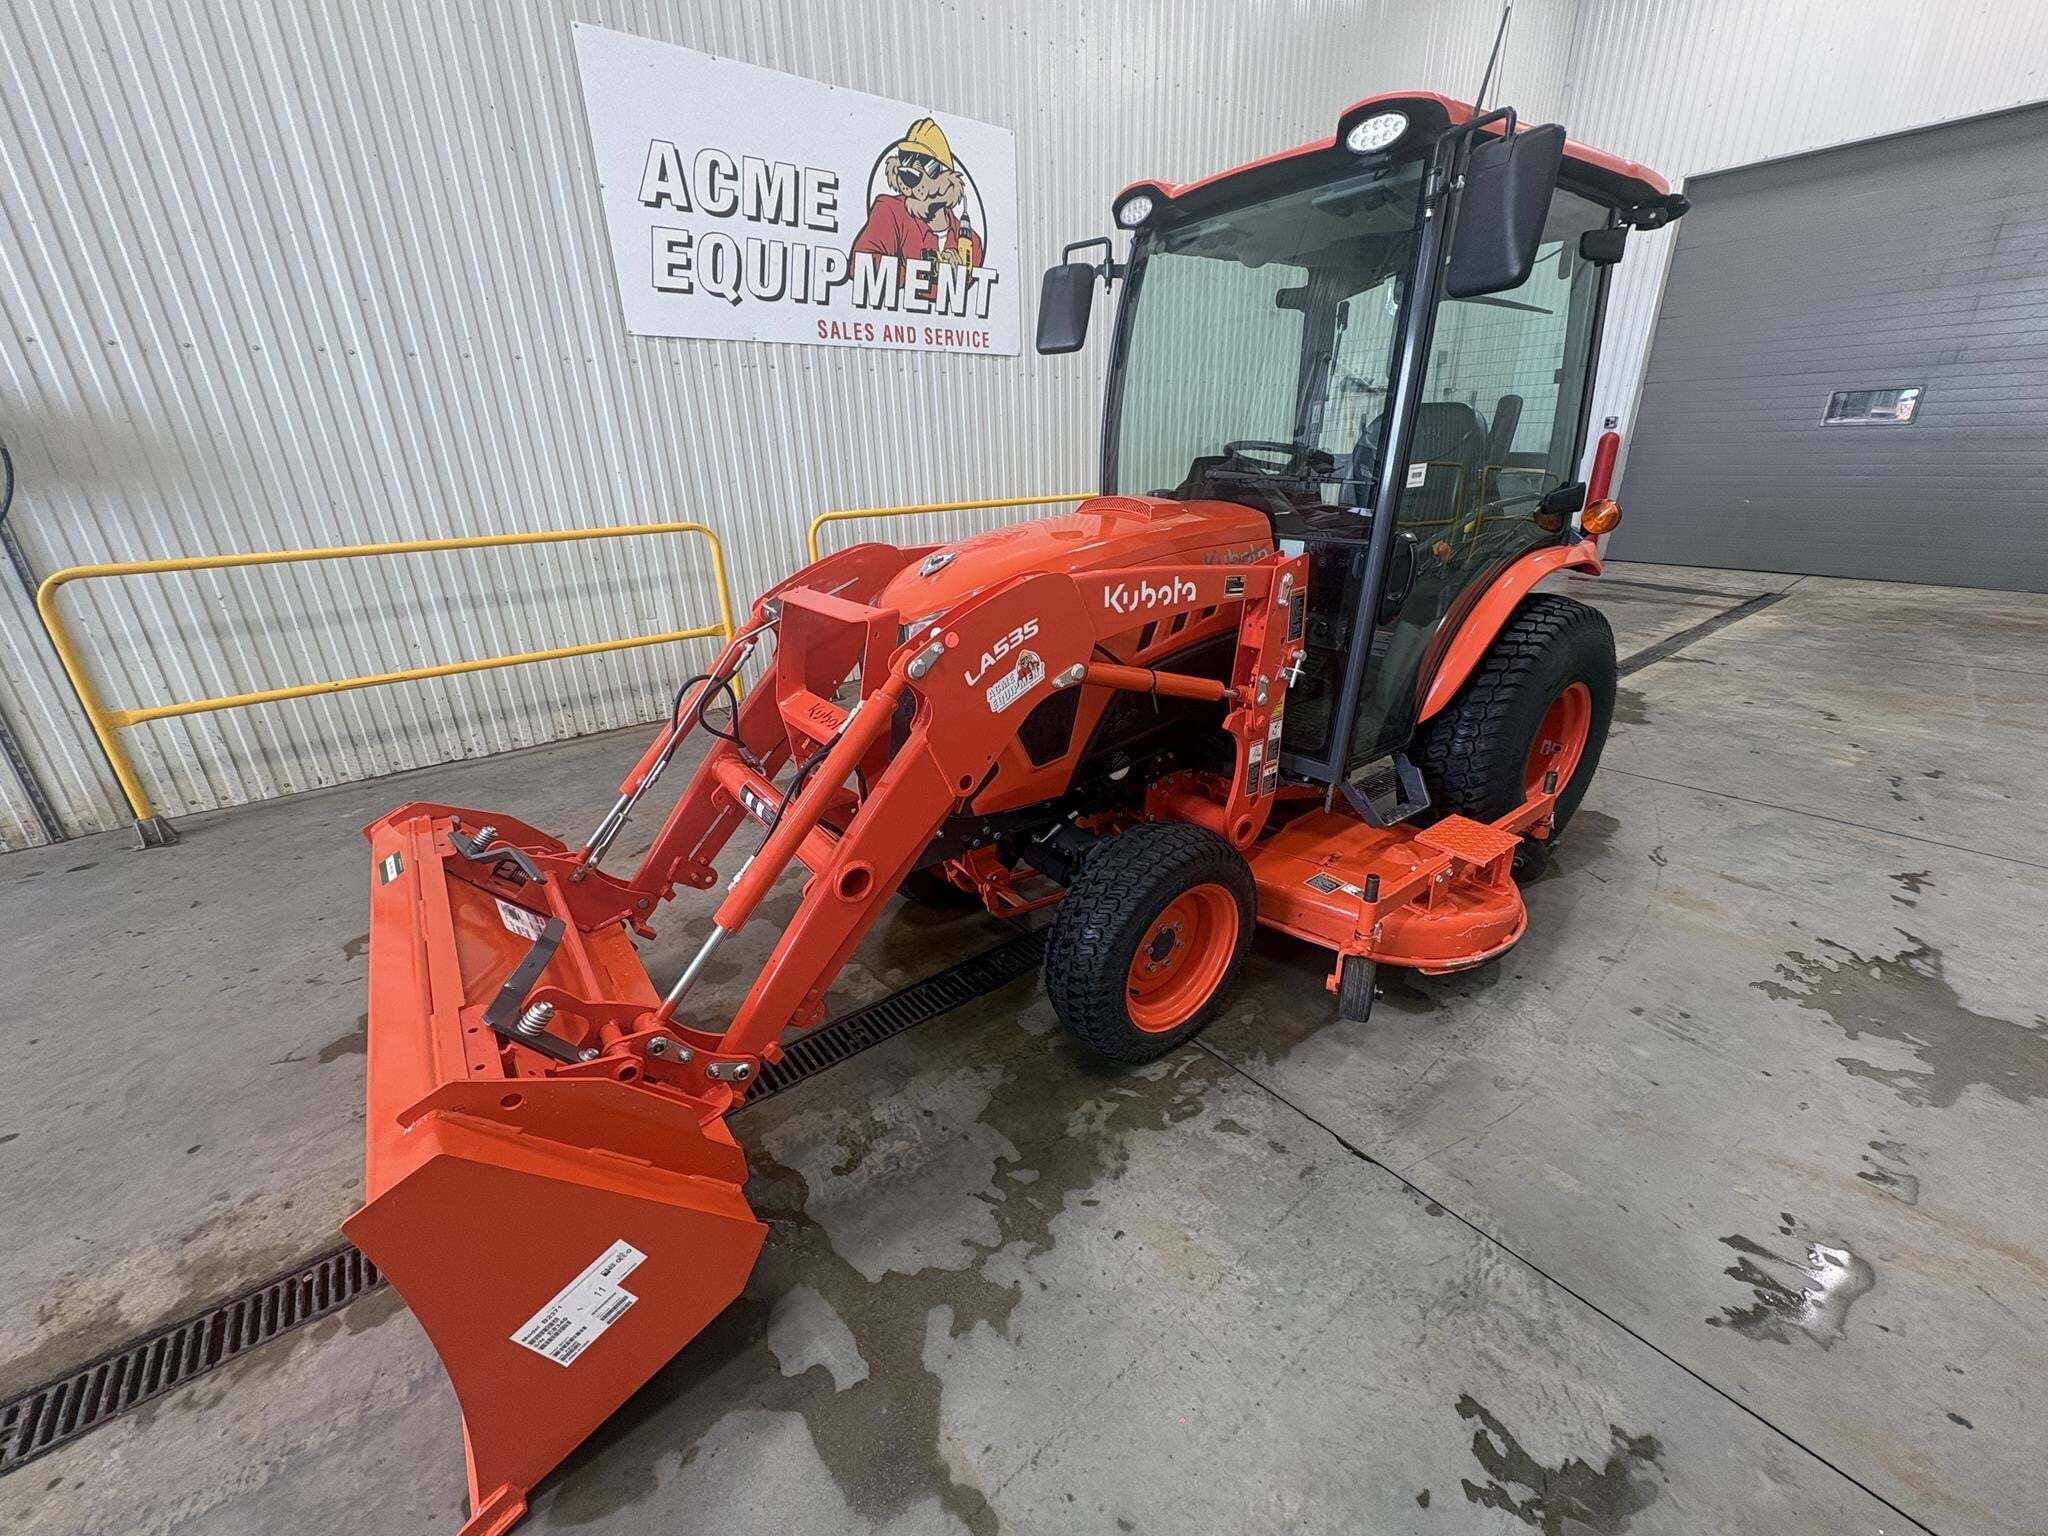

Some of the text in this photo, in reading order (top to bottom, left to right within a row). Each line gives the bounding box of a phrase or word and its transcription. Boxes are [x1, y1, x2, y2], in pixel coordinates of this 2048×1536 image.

[637, 138, 839, 233] ACME
[650, 225, 1000, 320] EQUIPMENT
[816, 319, 991, 349] SALES AND SERVICE
[1103, 575, 1198, 614] Kubota
[964, 617, 1040, 687] LA535
[988, 673, 1017, 700] ACME
[991, 662, 1046, 711] EQUIPMENT
[808, 702, 848, 731] Kubot
